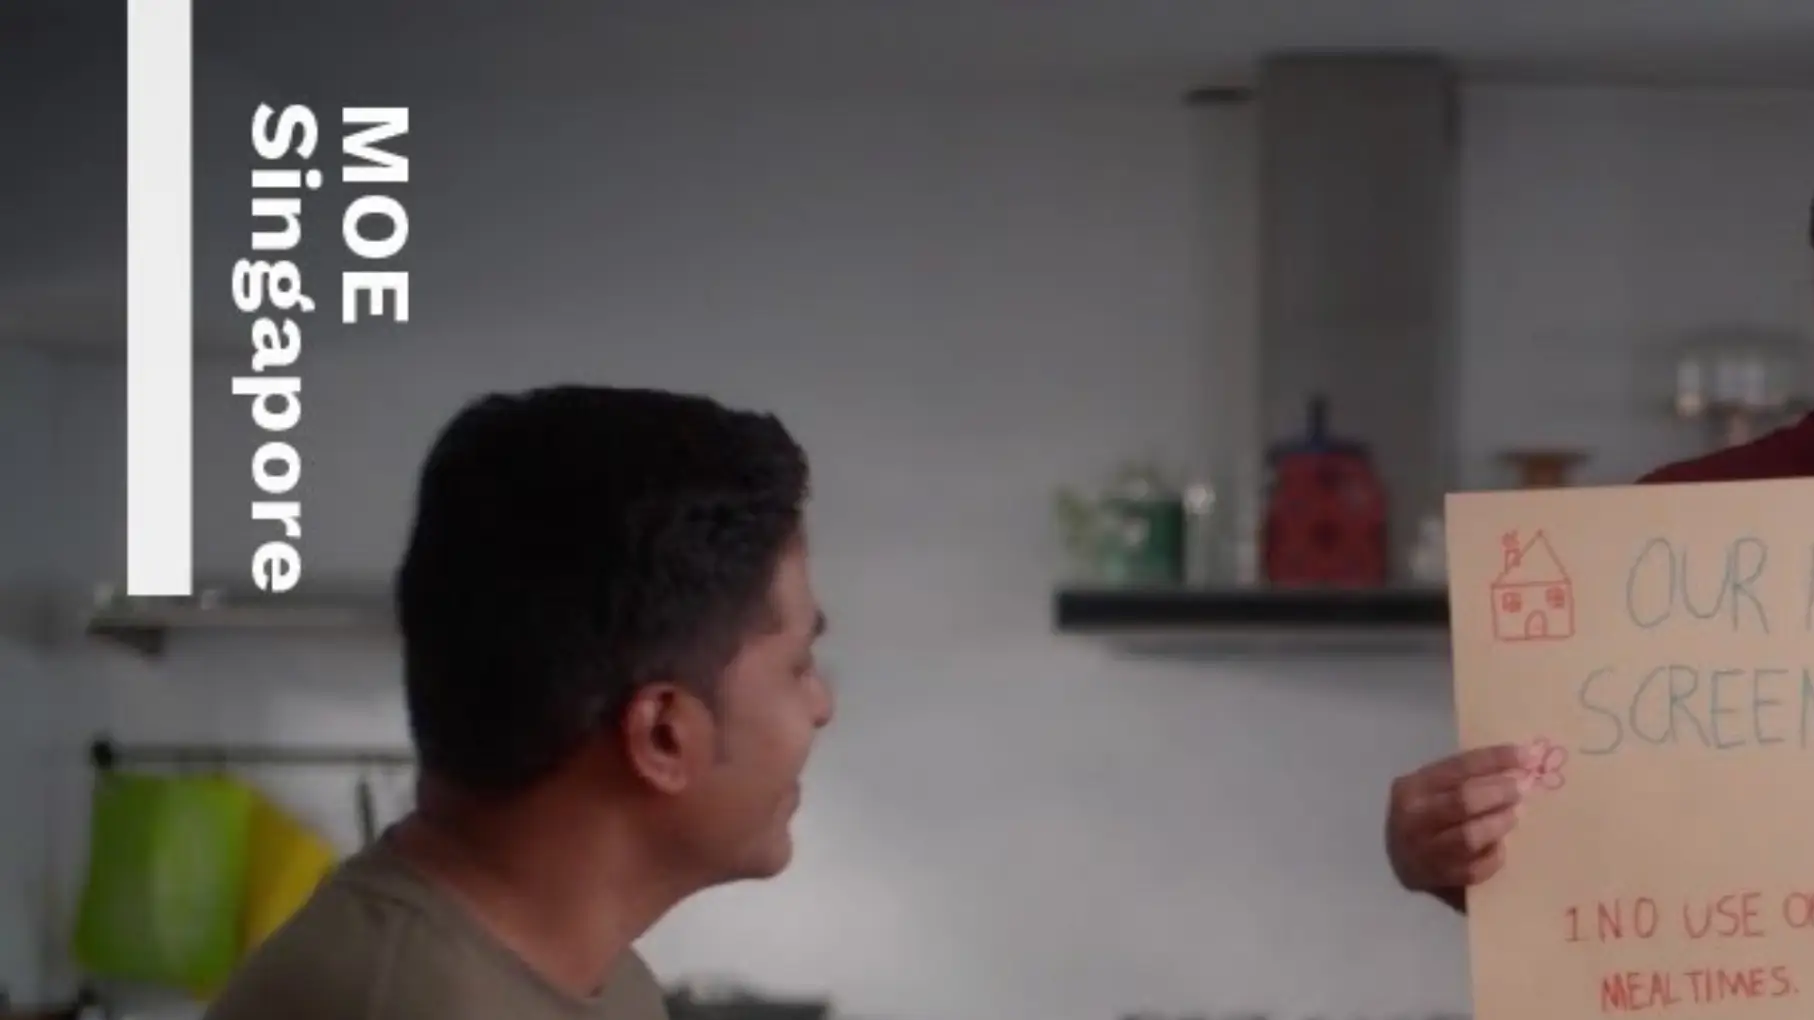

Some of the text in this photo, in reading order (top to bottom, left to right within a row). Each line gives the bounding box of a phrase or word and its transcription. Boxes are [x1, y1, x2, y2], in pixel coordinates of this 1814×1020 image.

[1626, 537, 1770, 636] OUR
[1597, 896, 1659, 943] NO
[1683, 891, 1764, 939] USE
